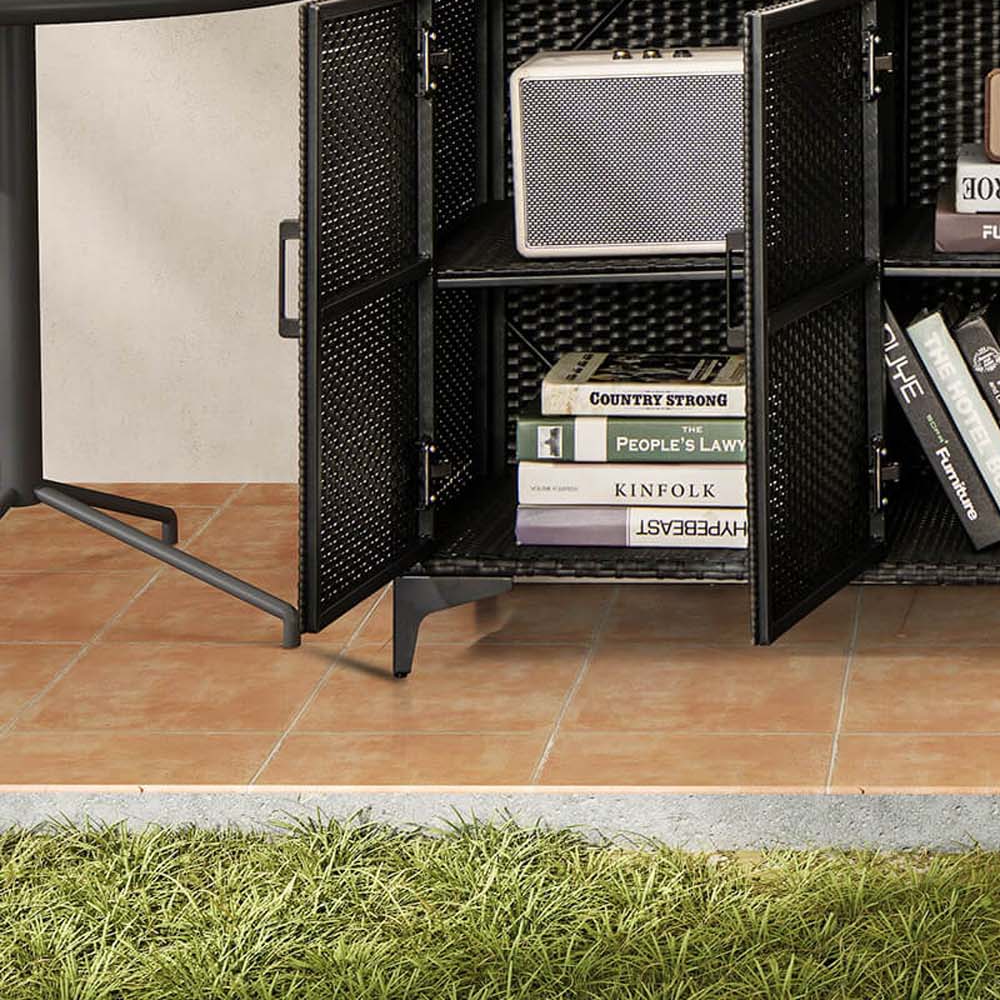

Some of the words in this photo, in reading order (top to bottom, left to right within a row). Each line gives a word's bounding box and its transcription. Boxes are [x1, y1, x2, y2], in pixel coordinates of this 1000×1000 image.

[589, 391, 663, 407] COUNTRY
[666, 393, 728, 407] STRONG
[924, 331, 956, 380] THE
[946, 377, 992, 454] HOTEL
[616, 437, 695, 452] PEOPLE'S
[615, 483, 716, 498] KINFOLK
[935, 447, 978, 521] Furniture
[636, 519, 747, 536] HYPEBEAST
